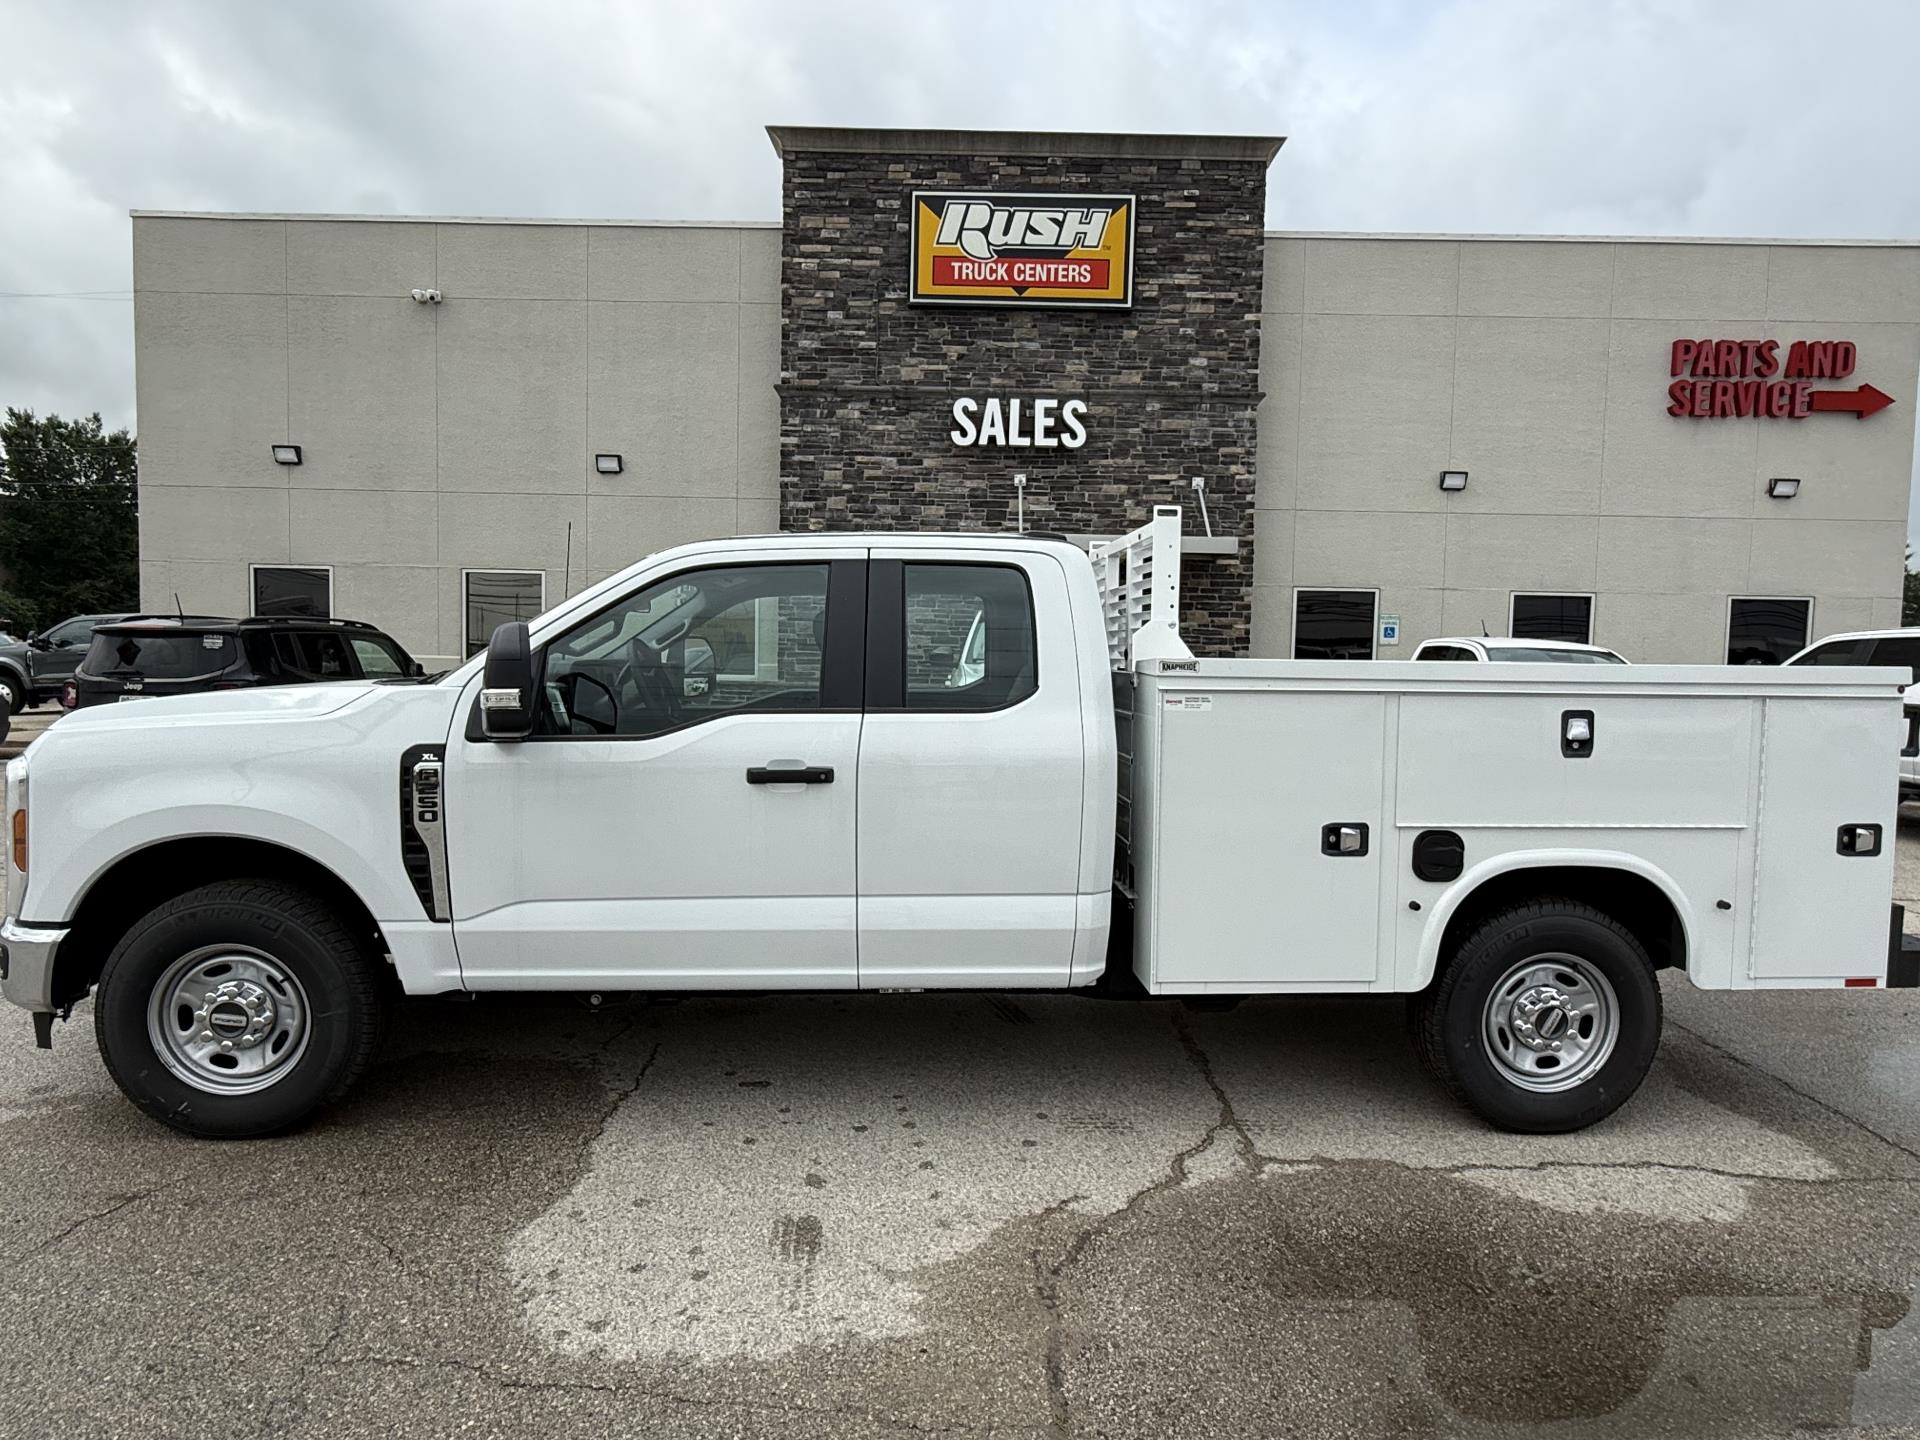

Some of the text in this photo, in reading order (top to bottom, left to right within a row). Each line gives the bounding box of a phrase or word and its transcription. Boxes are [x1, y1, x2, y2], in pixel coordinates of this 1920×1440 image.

[936, 201, 1111, 260] RUSH
[951, 262, 1091, 283] TRUCK CENTERS
[1670, 339, 1857, 378] PARTS AND
[1667, 380, 1813, 418] SERVICE
[951, 397, 1088, 448] SALES
[1162, 662, 1197, 671] KNAPHEIDE
[123, 682, 143, 691] Jeep
